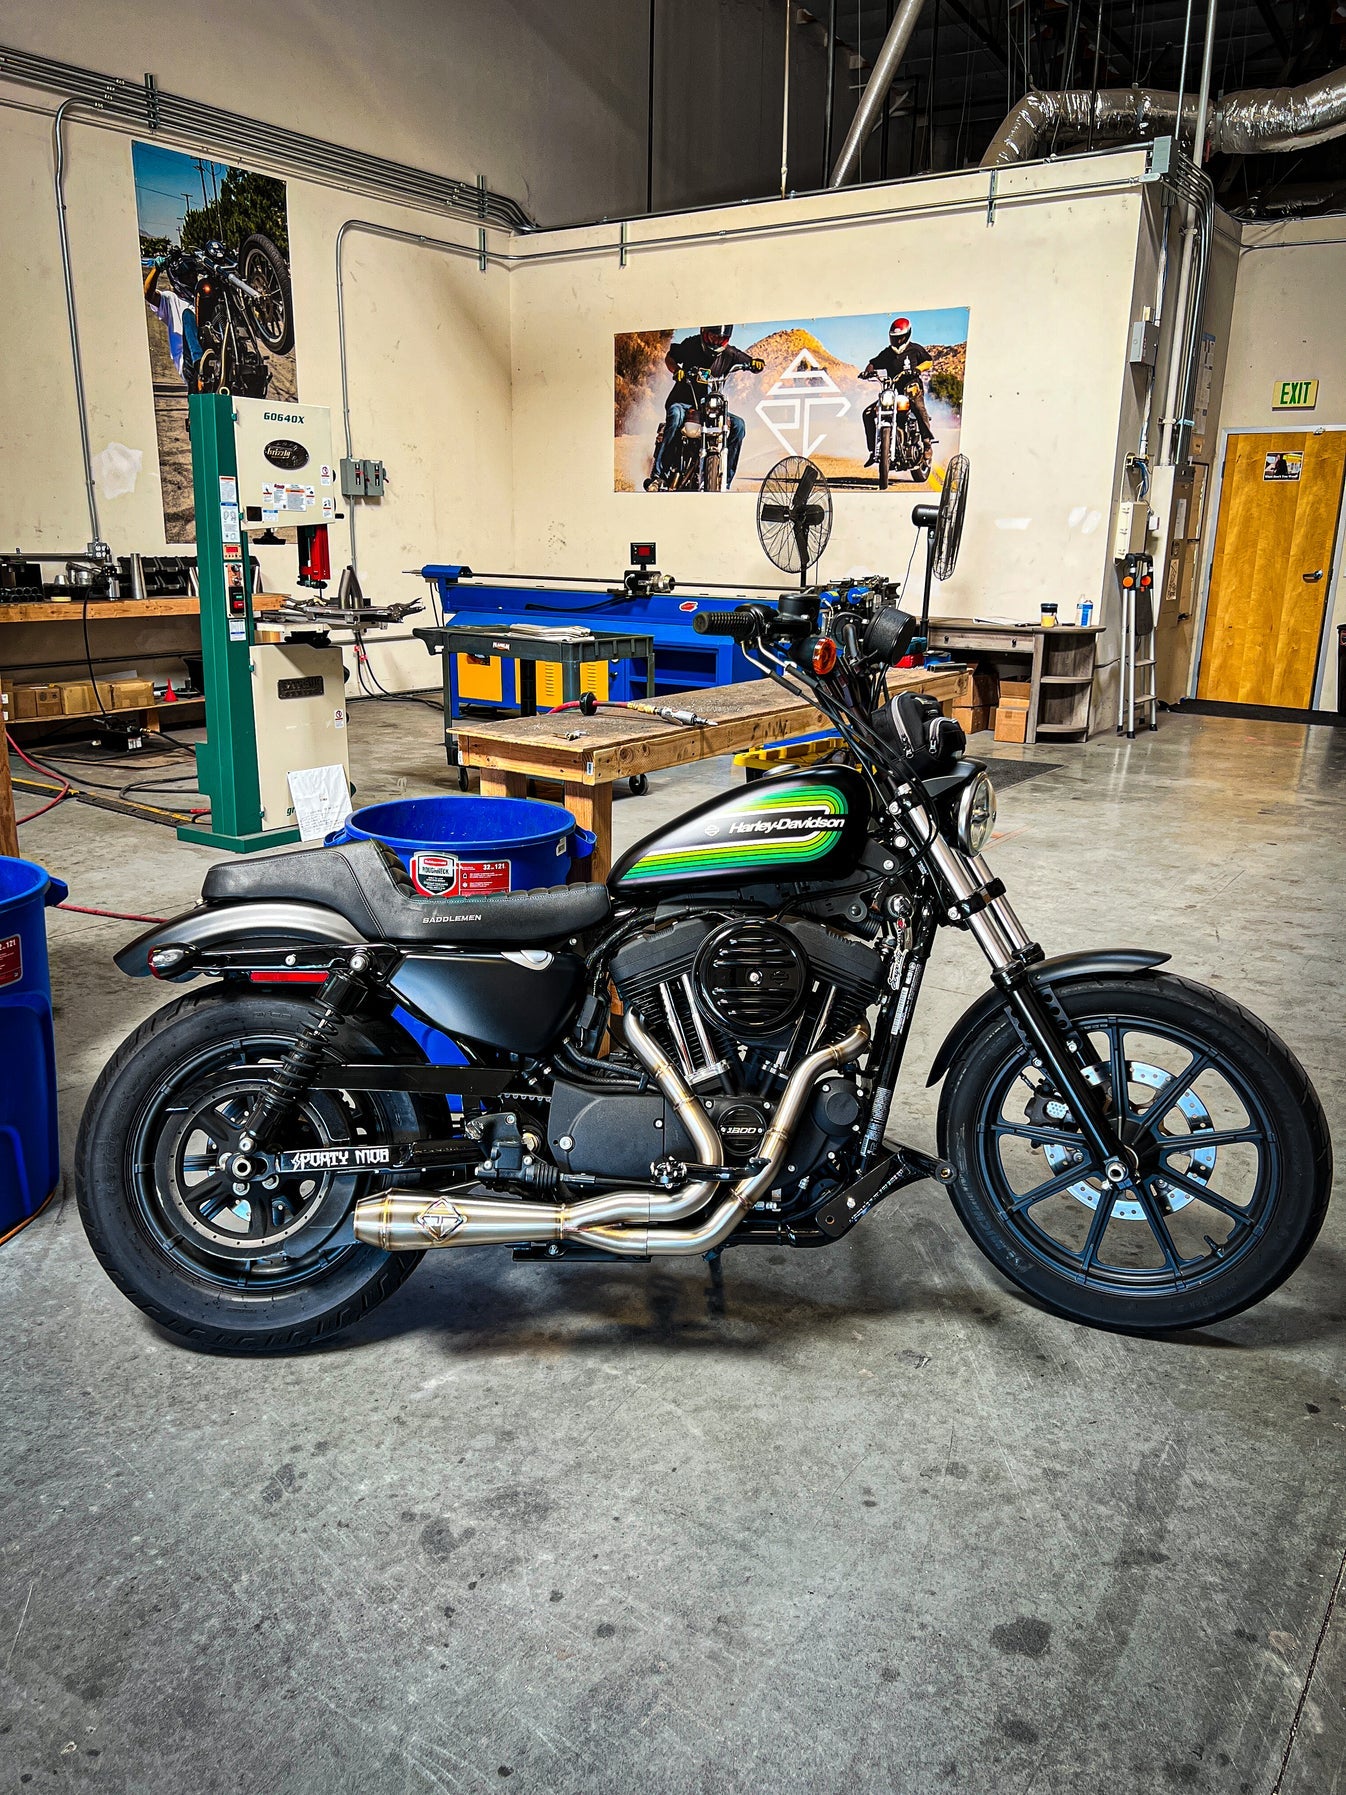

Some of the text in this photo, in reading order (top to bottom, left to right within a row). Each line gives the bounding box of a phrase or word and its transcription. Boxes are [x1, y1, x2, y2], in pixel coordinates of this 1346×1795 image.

[1280, 381, 1312, 405] EXIT
[729, 816, 845, 834] Harley-Davidson
[483, 863, 491, 871] 32
[494, 862, 505, 870] 121
[422, 914, 482, 924] SADDLEMEN
[291, 1148, 390, 1171] SPORTY MOB
